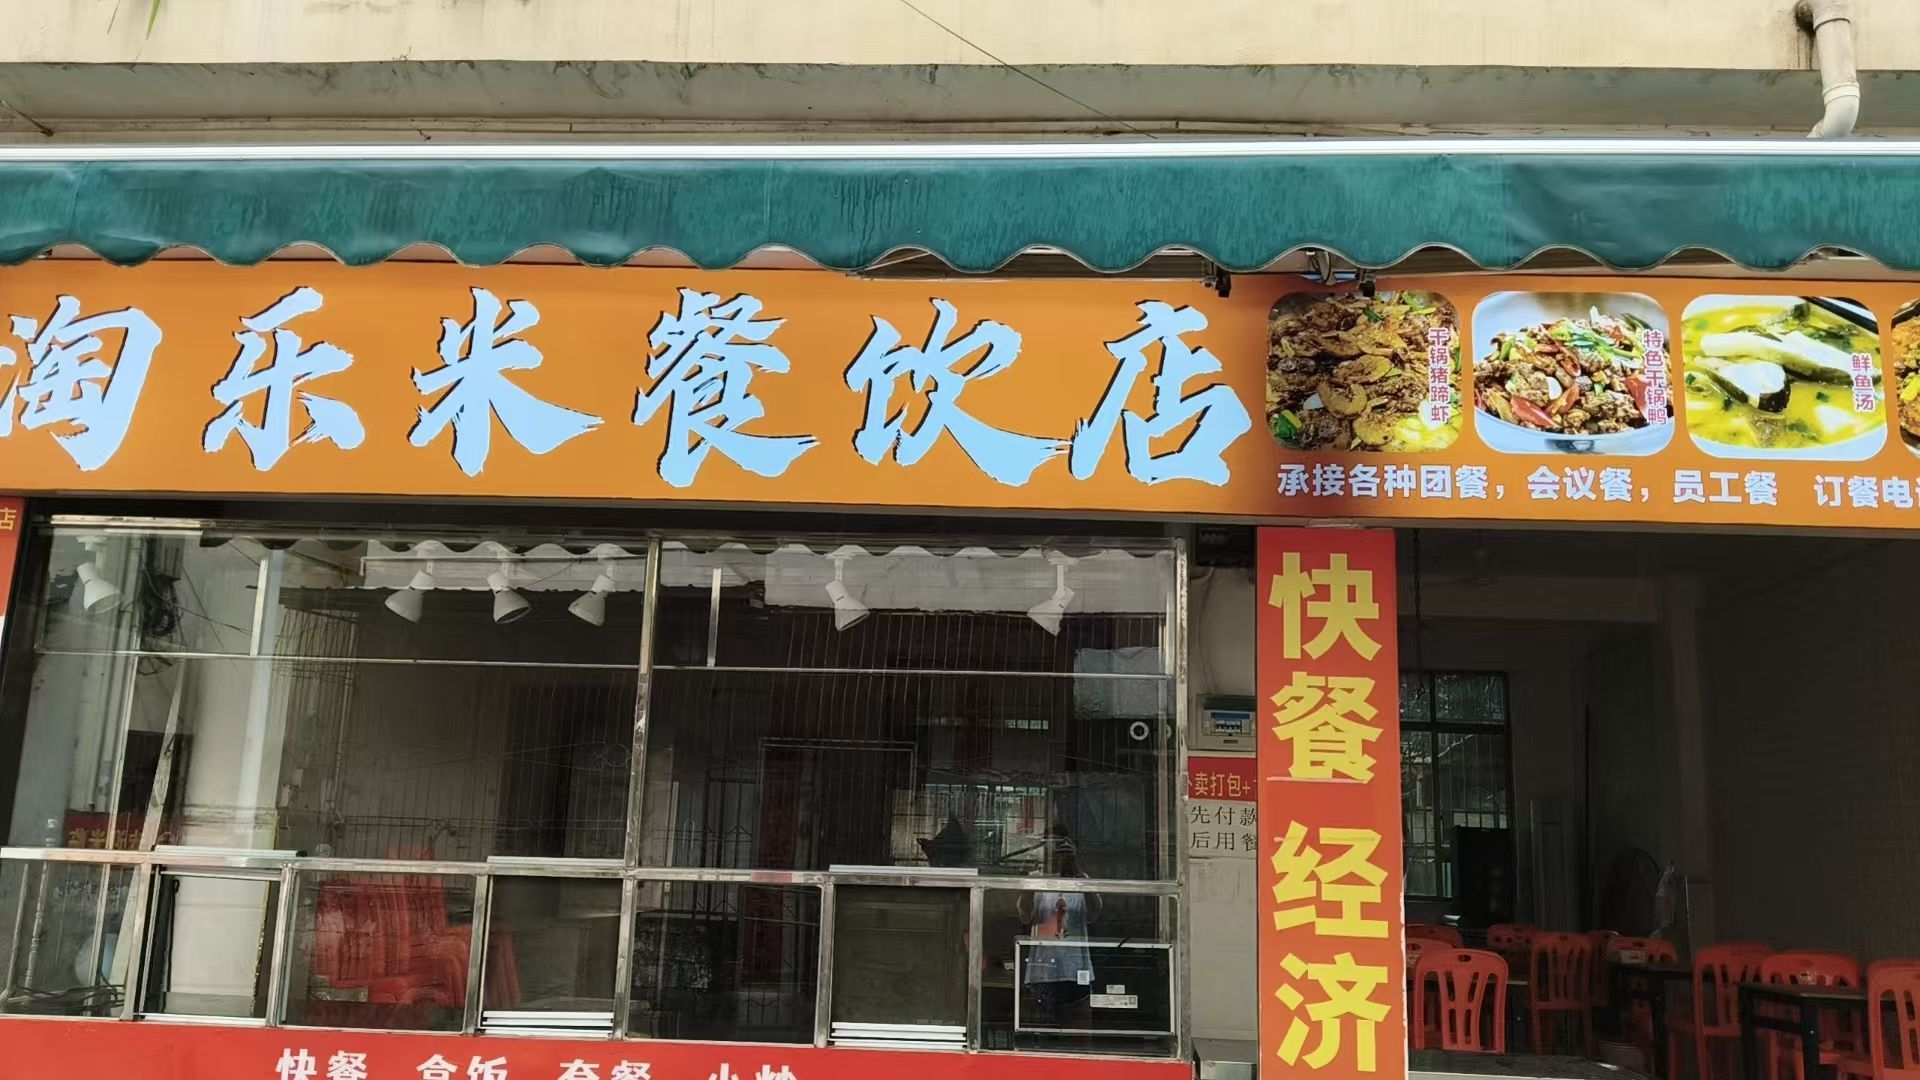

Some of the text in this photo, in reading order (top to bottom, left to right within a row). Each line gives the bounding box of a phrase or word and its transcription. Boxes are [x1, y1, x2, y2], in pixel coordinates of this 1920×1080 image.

[0, 285, 1252, 489] 淘乐米餐饮店
[1428, 327, 1449, 424] 干锅猪蹄虾
[1643, 329, 1667, 426] 特色干锅鸭
[1852, 353, 1874, 411] 鲜鱼汤
[1814, 474, 1920, 508] 订餐电
[1188, 771, 1257, 797] 卖打包+
[1190, 805, 1257, 826] 先付款
[1268, 552, 1391, 1072] 快餐 经济
